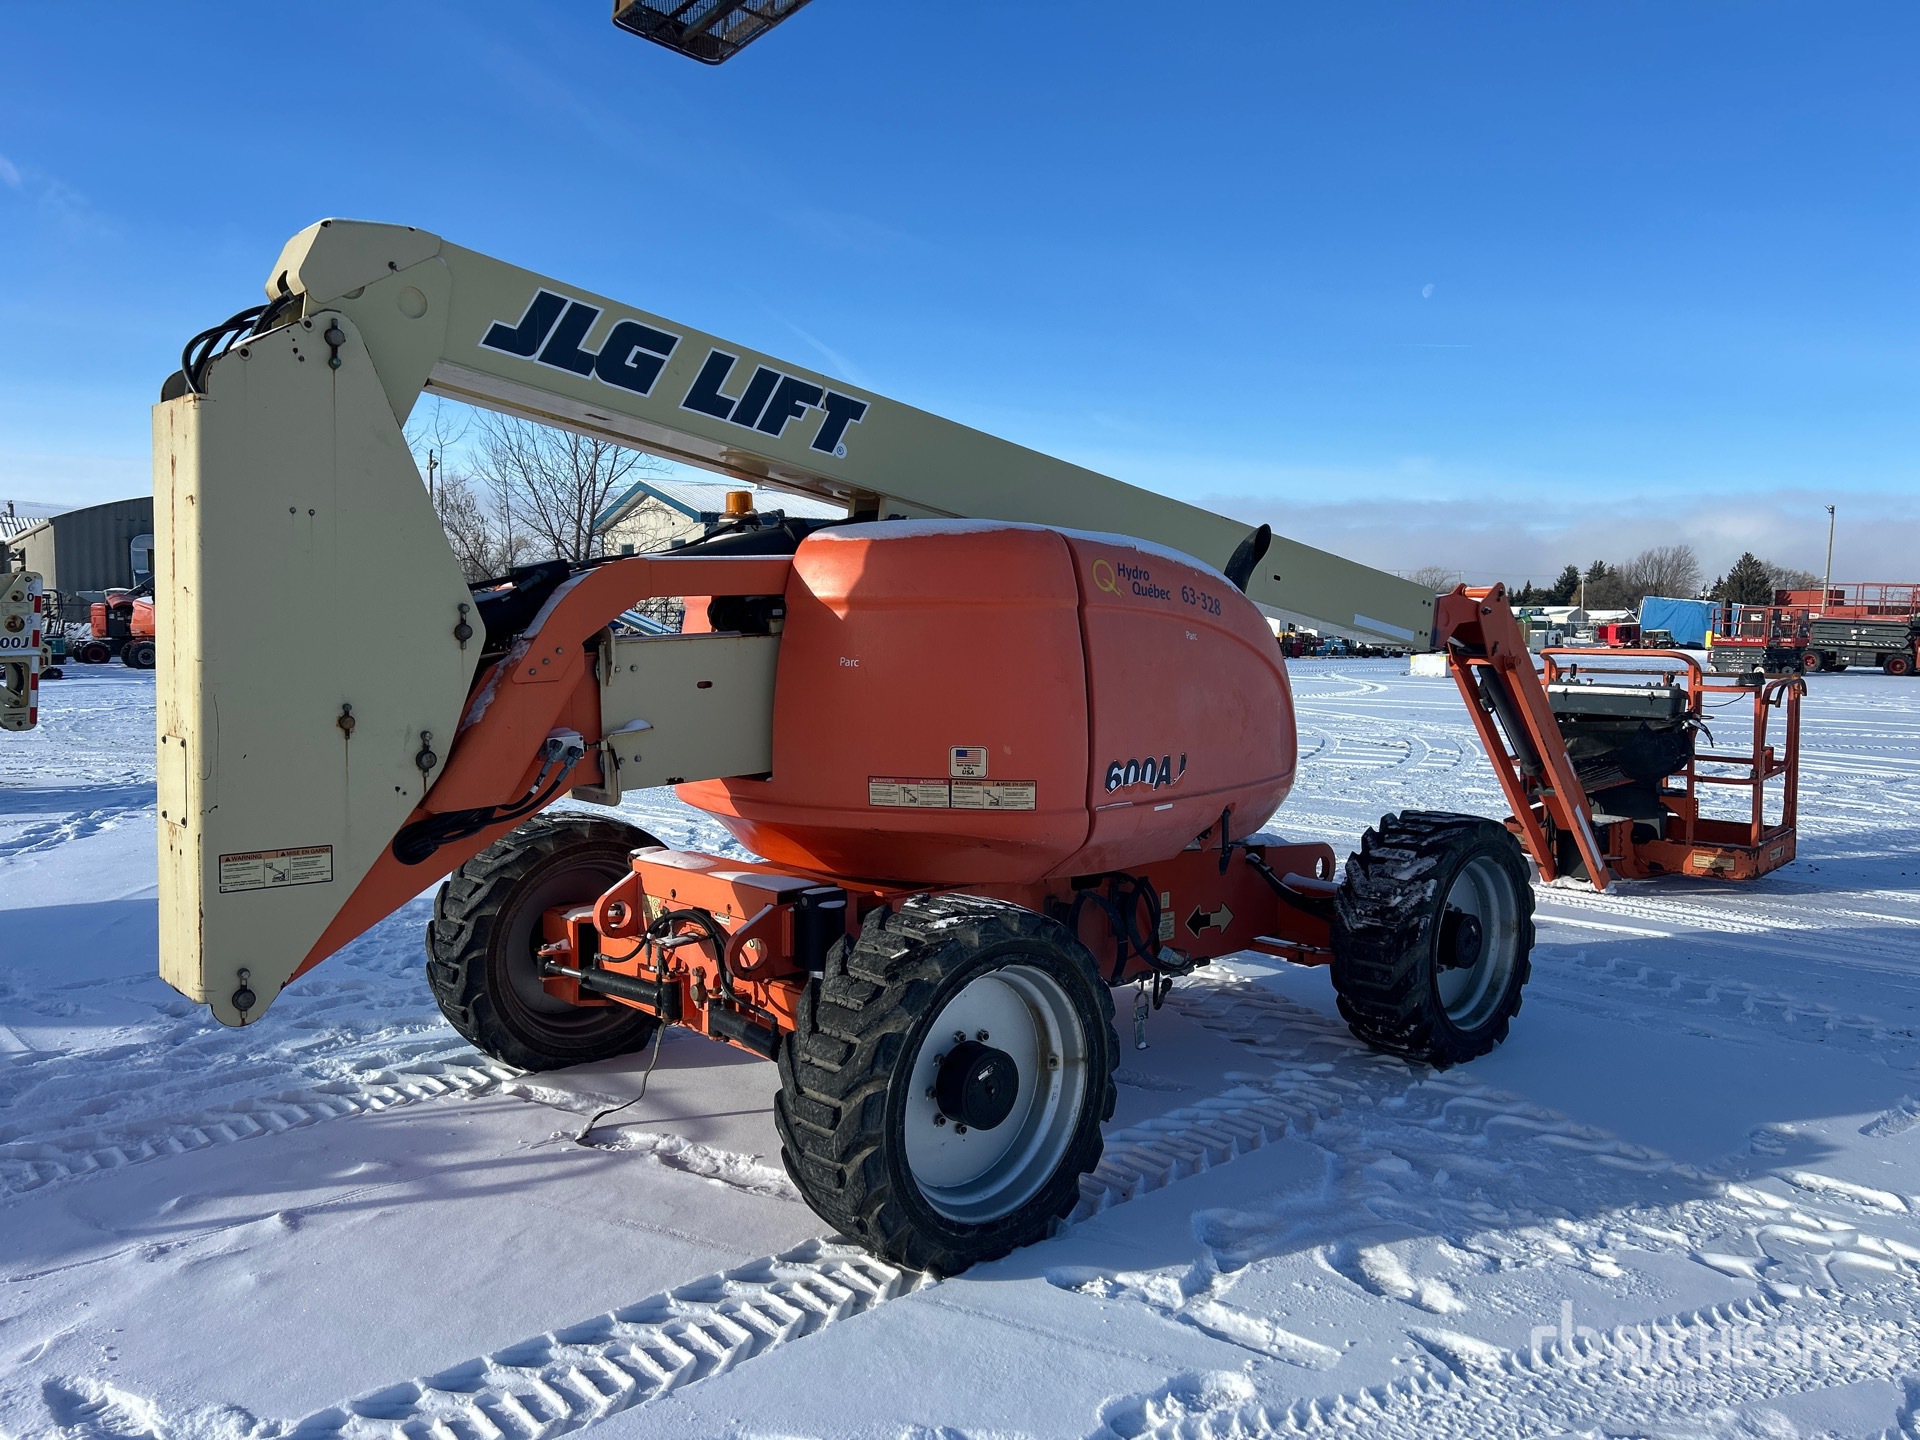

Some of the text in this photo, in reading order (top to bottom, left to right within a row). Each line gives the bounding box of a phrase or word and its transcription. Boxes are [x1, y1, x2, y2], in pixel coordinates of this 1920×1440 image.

[478, 287, 872, 456] JLG LIFT
[1117, 562, 1150, 582] Hydro
[1132, 581, 1222, 617] Québec 63-328
[1185, 630, 1198, 641] Parc
[839, 656, 859, 667] Parc
